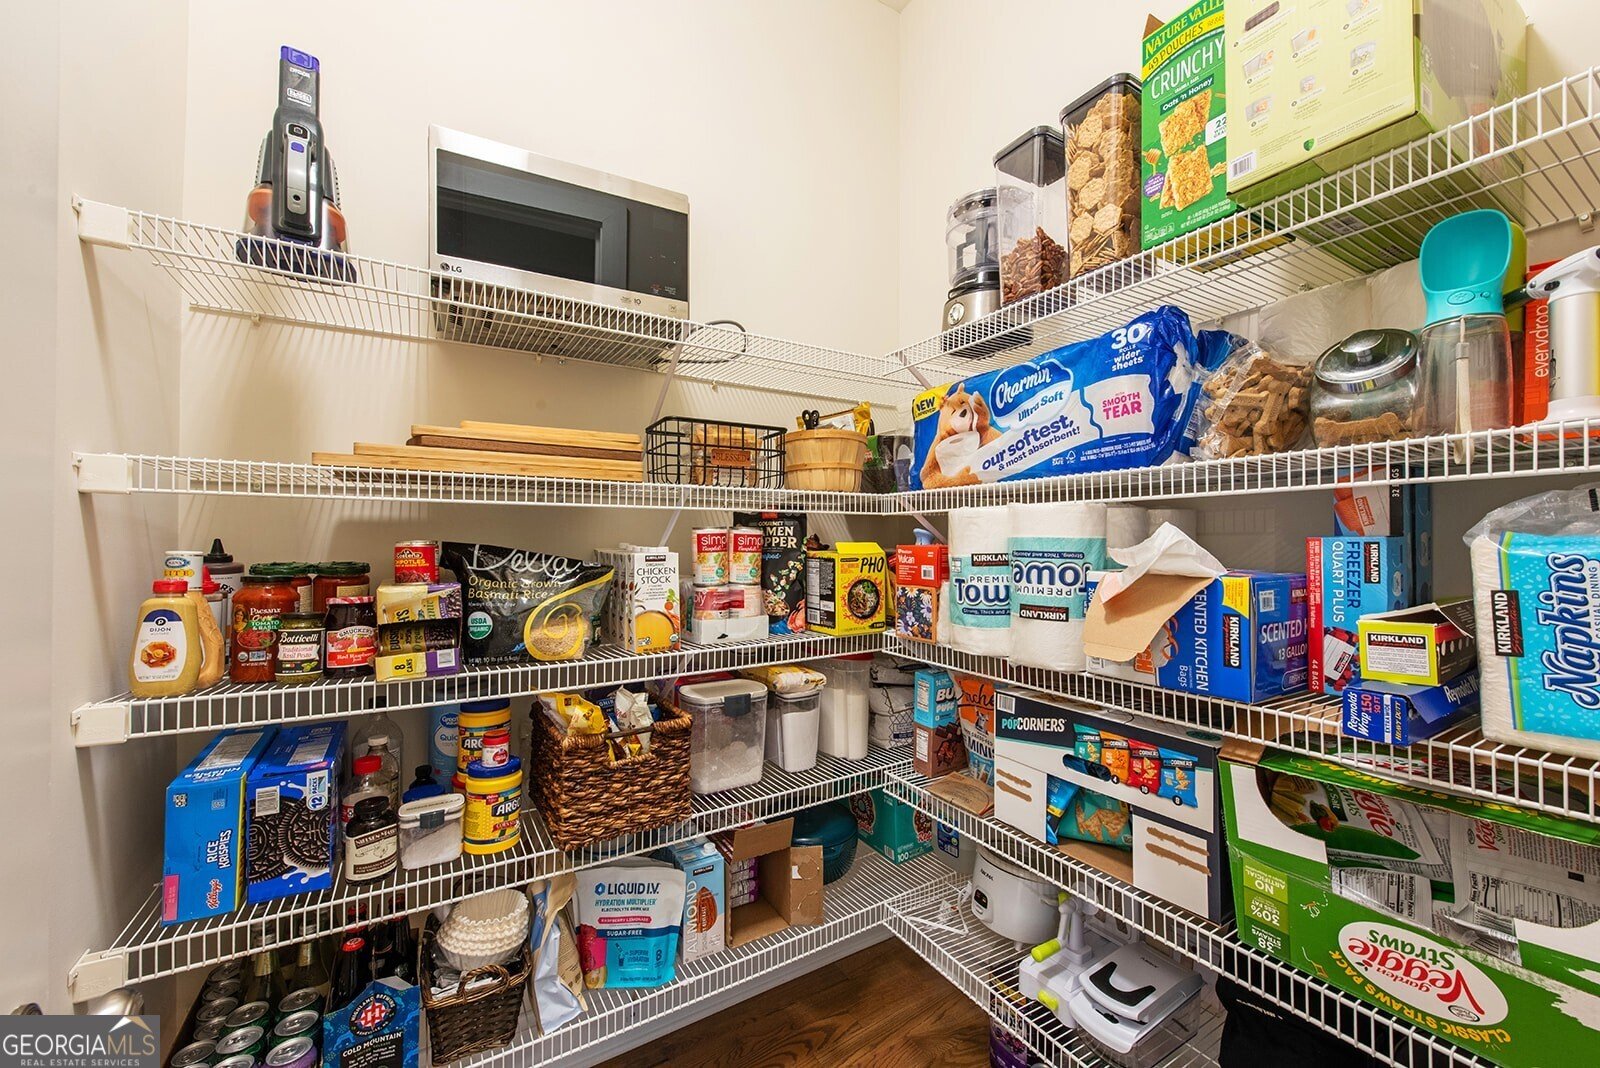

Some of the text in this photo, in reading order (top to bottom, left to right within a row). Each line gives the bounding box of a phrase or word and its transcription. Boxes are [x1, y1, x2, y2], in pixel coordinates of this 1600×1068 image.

[1145, 16, 1189, 60] NATURE
[1188, 0, 1224, 22] VALLE
[1148, 57, 1159, 71] 49
[1160, 22, 1204, 61] POUCHES
[1151, 33, 1226, 99] CRUNCHY
[1162, 98, 1179, 111] Oats
[1189, 77, 1213, 96] Honey
[451, 265, 462, 273] LG
[1111, 326, 1144, 350] 30
[1529, 304, 1549, 378] everydrop
[1111, 355, 1144, 372] sheets
[1114, 349, 1141, 363] wider
[995, 365, 1052, 407] Charmin
[1018, 391, 1064, 421] Ultra Soft
[1102, 392, 1140, 408] SMOOTH
[1103, 401, 1142, 420] TEAR
[981, 447, 1007, 471] our
[1007, 414, 1075, 456] softest,
[1006, 451, 1028, 467] most
[1028, 426, 1081, 456] absorbent!
[715, 453, 747, 462] BLESSED
[701, 536, 727, 548] simp
[737, 536, 763, 548] simp
[764, 537, 798, 548] PPER
[766, 526, 794, 536] MEN
[468, 544, 581, 579] Della
[860, 557, 884, 573] PHO
[973, 554, 1008, 562] KIRKLAN
[1370, 543, 1379, 583] KIRKLAND
[468, 576, 518, 589] Organic
[637, 567, 676, 576] CHICKEN
[641, 576, 671, 584] STOCK
[1332, 541, 1344, 622] QUART PLUS
[1346, 541, 1360, 609] FREEZER
[468, 588, 548, 599] Basmati Rice
[955, 579, 1010, 604] Tow
[1588, 566, 1600, 639] CASUAL DINING
[1020, 609, 1066, 620] KIRKLAND
[1493, 592, 1511, 654] KIRKLAND
[1510, 598, 1524, 655] Signature
[280, 632, 319, 643] Botticelli
[1230, 616, 1240, 667] KIRKLAND
[1261, 620, 1302, 644] SCENTED
[1370, 634, 1424, 645] KIRKLAND
[1541, 552, 1600, 710] Napkins
[1194, 637, 1209, 691] KITCHEN
[1278, 644, 1307, 660] 13 GALLO
[1312, 659, 1319, 669] 44
[1178, 665, 1188, 688] Bags
[1361, 694, 1372, 713] 150
[1373, 696, 1380, 704] FT
[1444, 679, 1471, 704] Reynolds
[1002, 716, 1065, 732] POPCORNERS
[1347, 692, 1360, 732] Reynolds
[1358, 712, 1371, 736] Wrap
[310, 796, 323, 808] 12
[206, 840, 219, 864] RICE
[219, 829, 232, 869] KRISPIES
[607, 883, 660, 895] LIQUID I.V.
[1246, 869, 1285, 889] ARTIFICIAL
[1255, 880, 1274, 894] NO
[626, 898, 657, 906] MULTIPLIER
[1406, 875, 1415, 918] Nutrition Facts
[687, 880, 697, 953] ALMOND
[1251, 905, 1280, 926] 30%
[1258, 937, 1274, 953] 38
[1367, 929, 1455, 970] Straws
[1348, 938, 1485, 1015] Veggie
[1376, 967, 1431, 993] garden
[1329, 950, 1511, 1043] CLASSIC STRAWS PACK
[342, 1046, 362, 1057] COLD
[363, 1032, 402, 1049] MOUNTAIN
